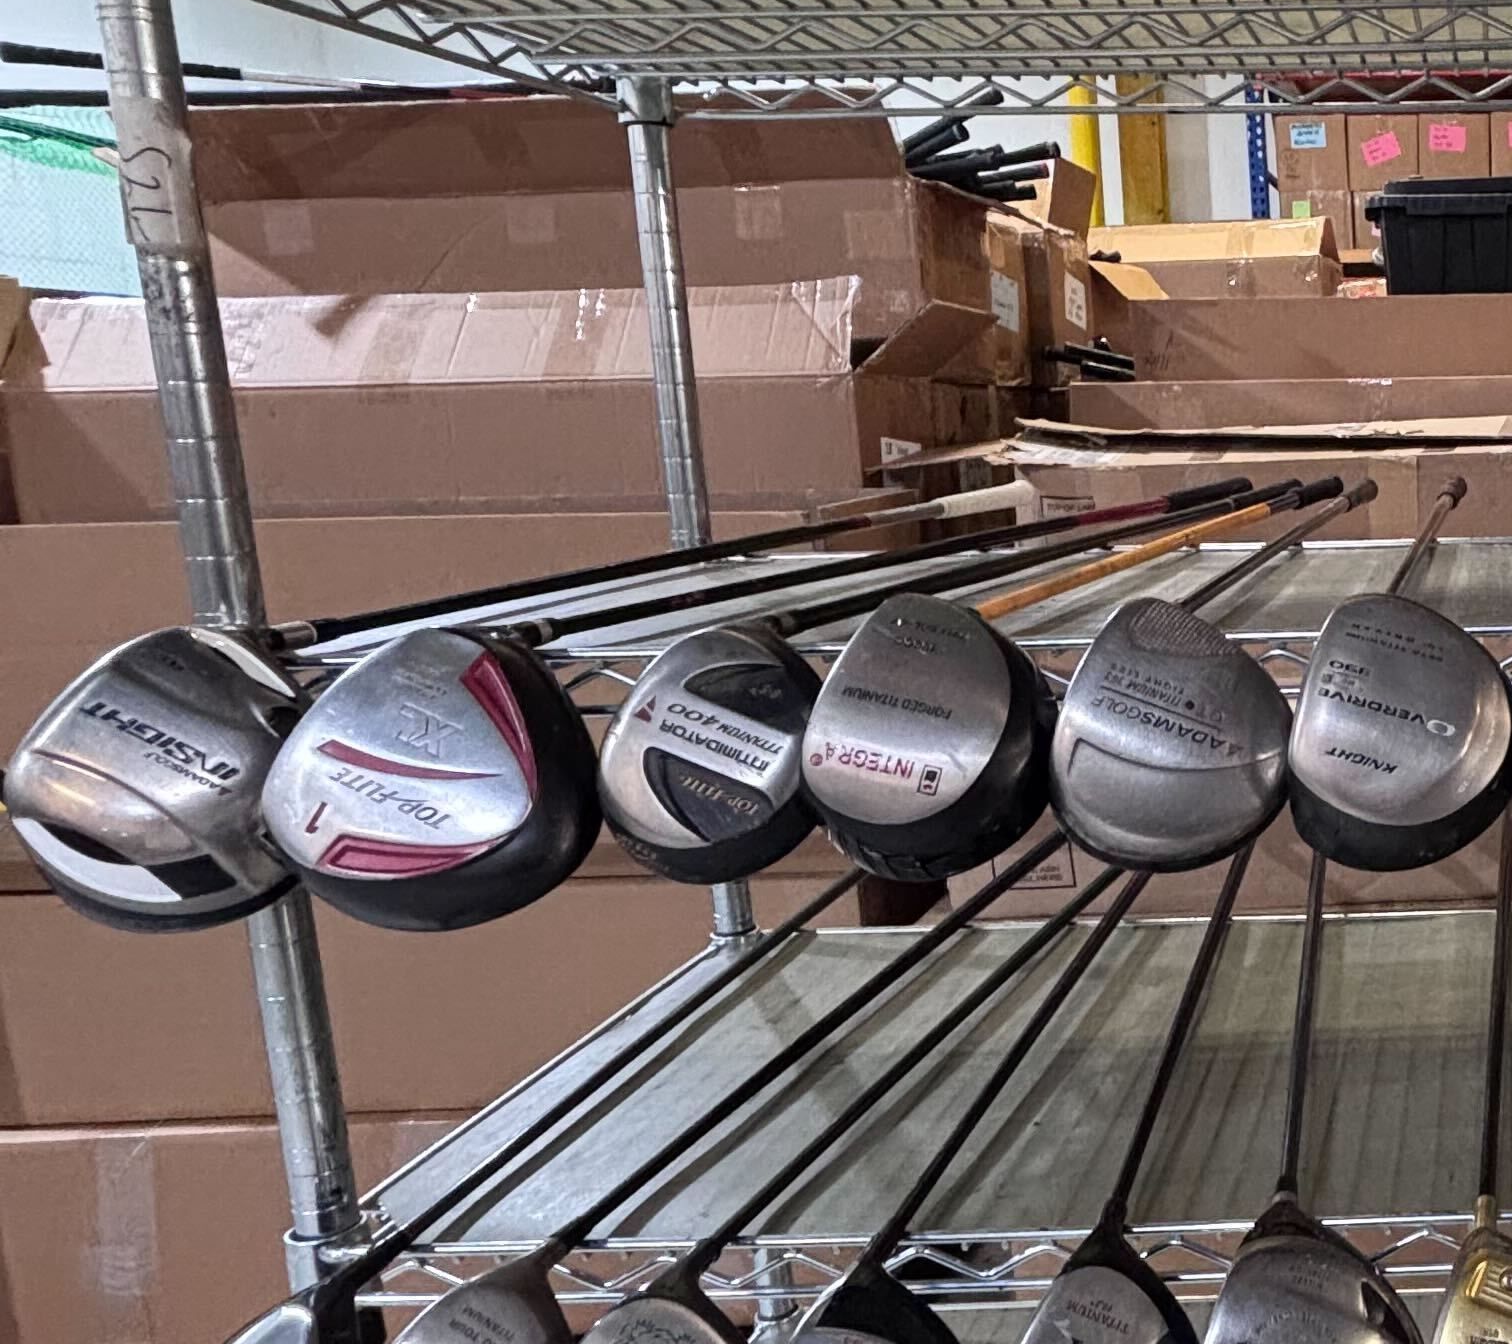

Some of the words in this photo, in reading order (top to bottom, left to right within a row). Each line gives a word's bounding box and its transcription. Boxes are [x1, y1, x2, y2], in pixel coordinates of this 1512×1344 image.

[842, 687, 899, 707] TITANIUM
[902, 697, 952, 720] FORGED
[1318, 687, 1456, 737] OVERDRIVE
[667, 703, 719, 727] 400
[1091, 695, 1227, 750] ADAMSGOLF
[80, 702, 240, 780] INSIGHT
[659, 719, 769, 773] INTIMIDATOR
[717, 724, 783, 755] TITANIUM
[825, 742, 915, 779] INTEGRA
[1326, 747, 1398, 774] KNIGHT
[305, 801, 328, 834] 1
[1066, 1300, 1130, 1335] TITANIUM
